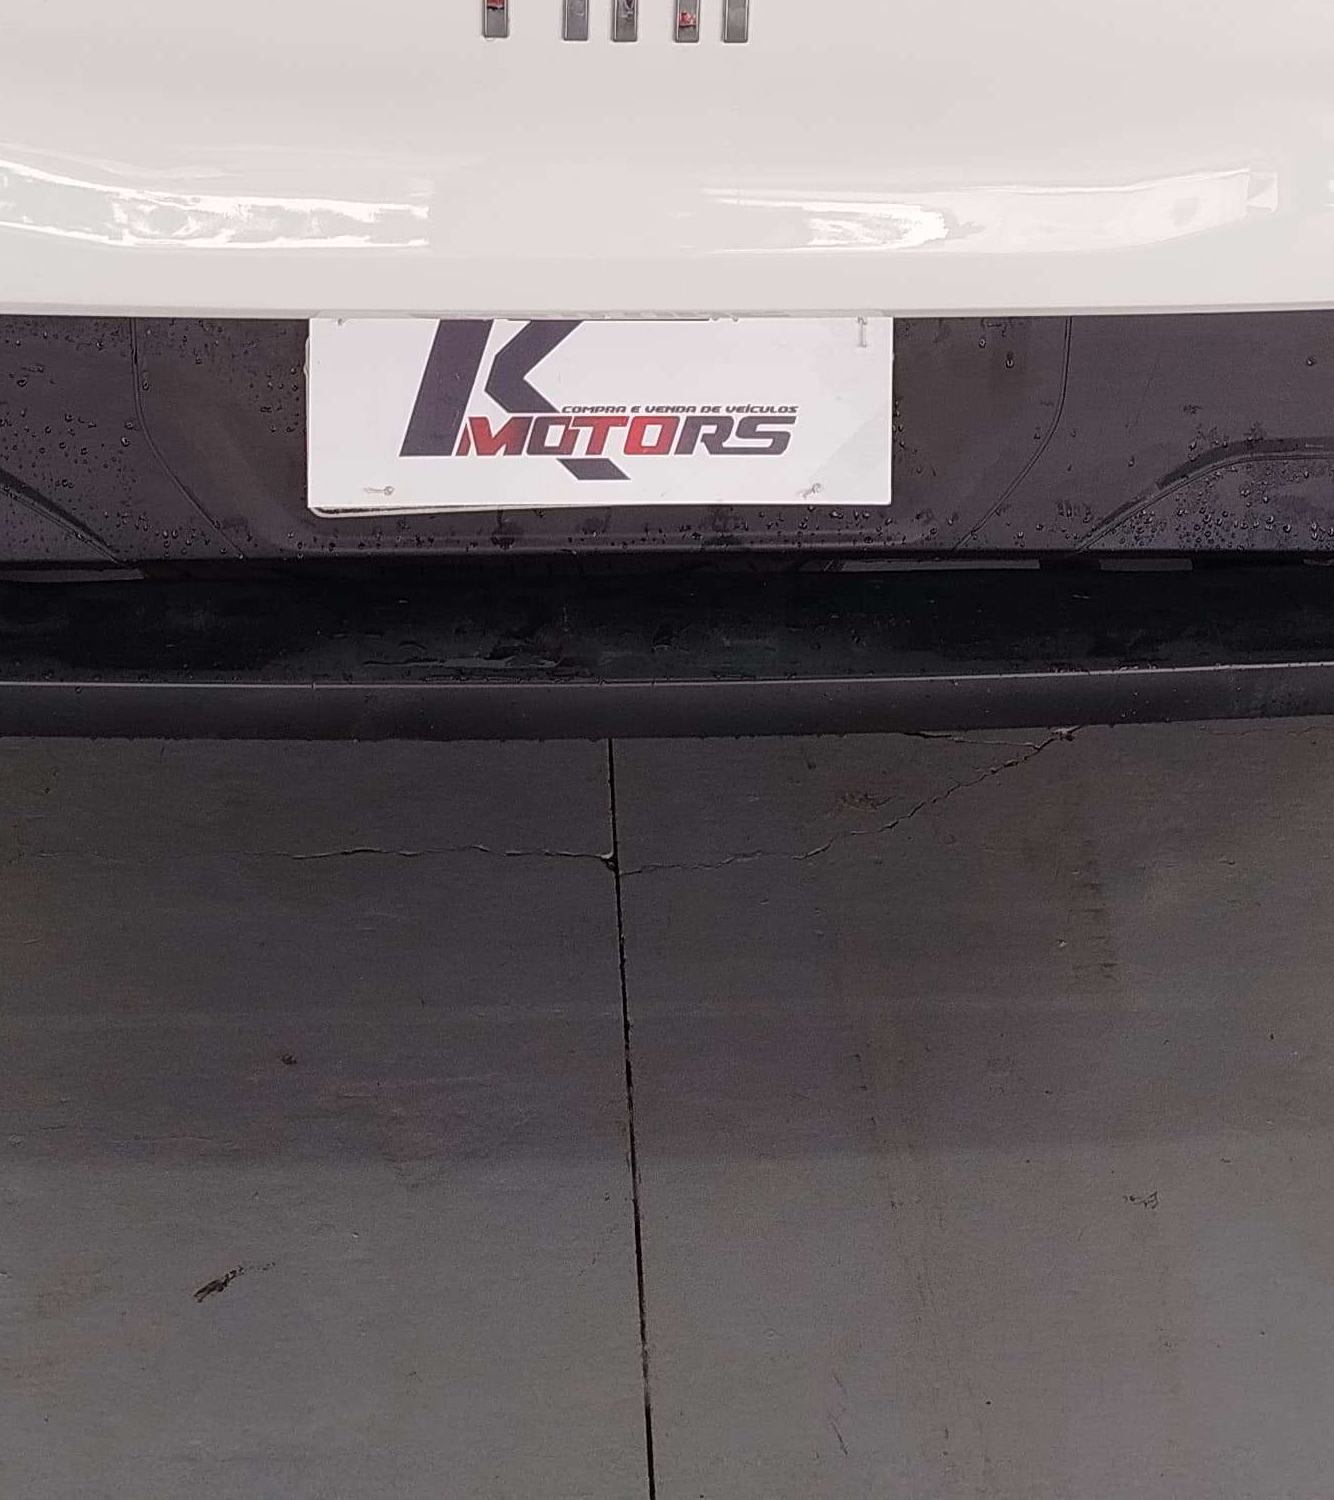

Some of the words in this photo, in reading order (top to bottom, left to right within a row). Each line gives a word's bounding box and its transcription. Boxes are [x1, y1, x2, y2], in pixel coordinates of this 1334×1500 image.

[561, 404, 627, 414] COMPRA
[630, 404, 641, 414] E
[644, 404, 697, 414] VENDA
[700, 404, 721, 414] DE
[455, 415, 798, 457] MOTORS
